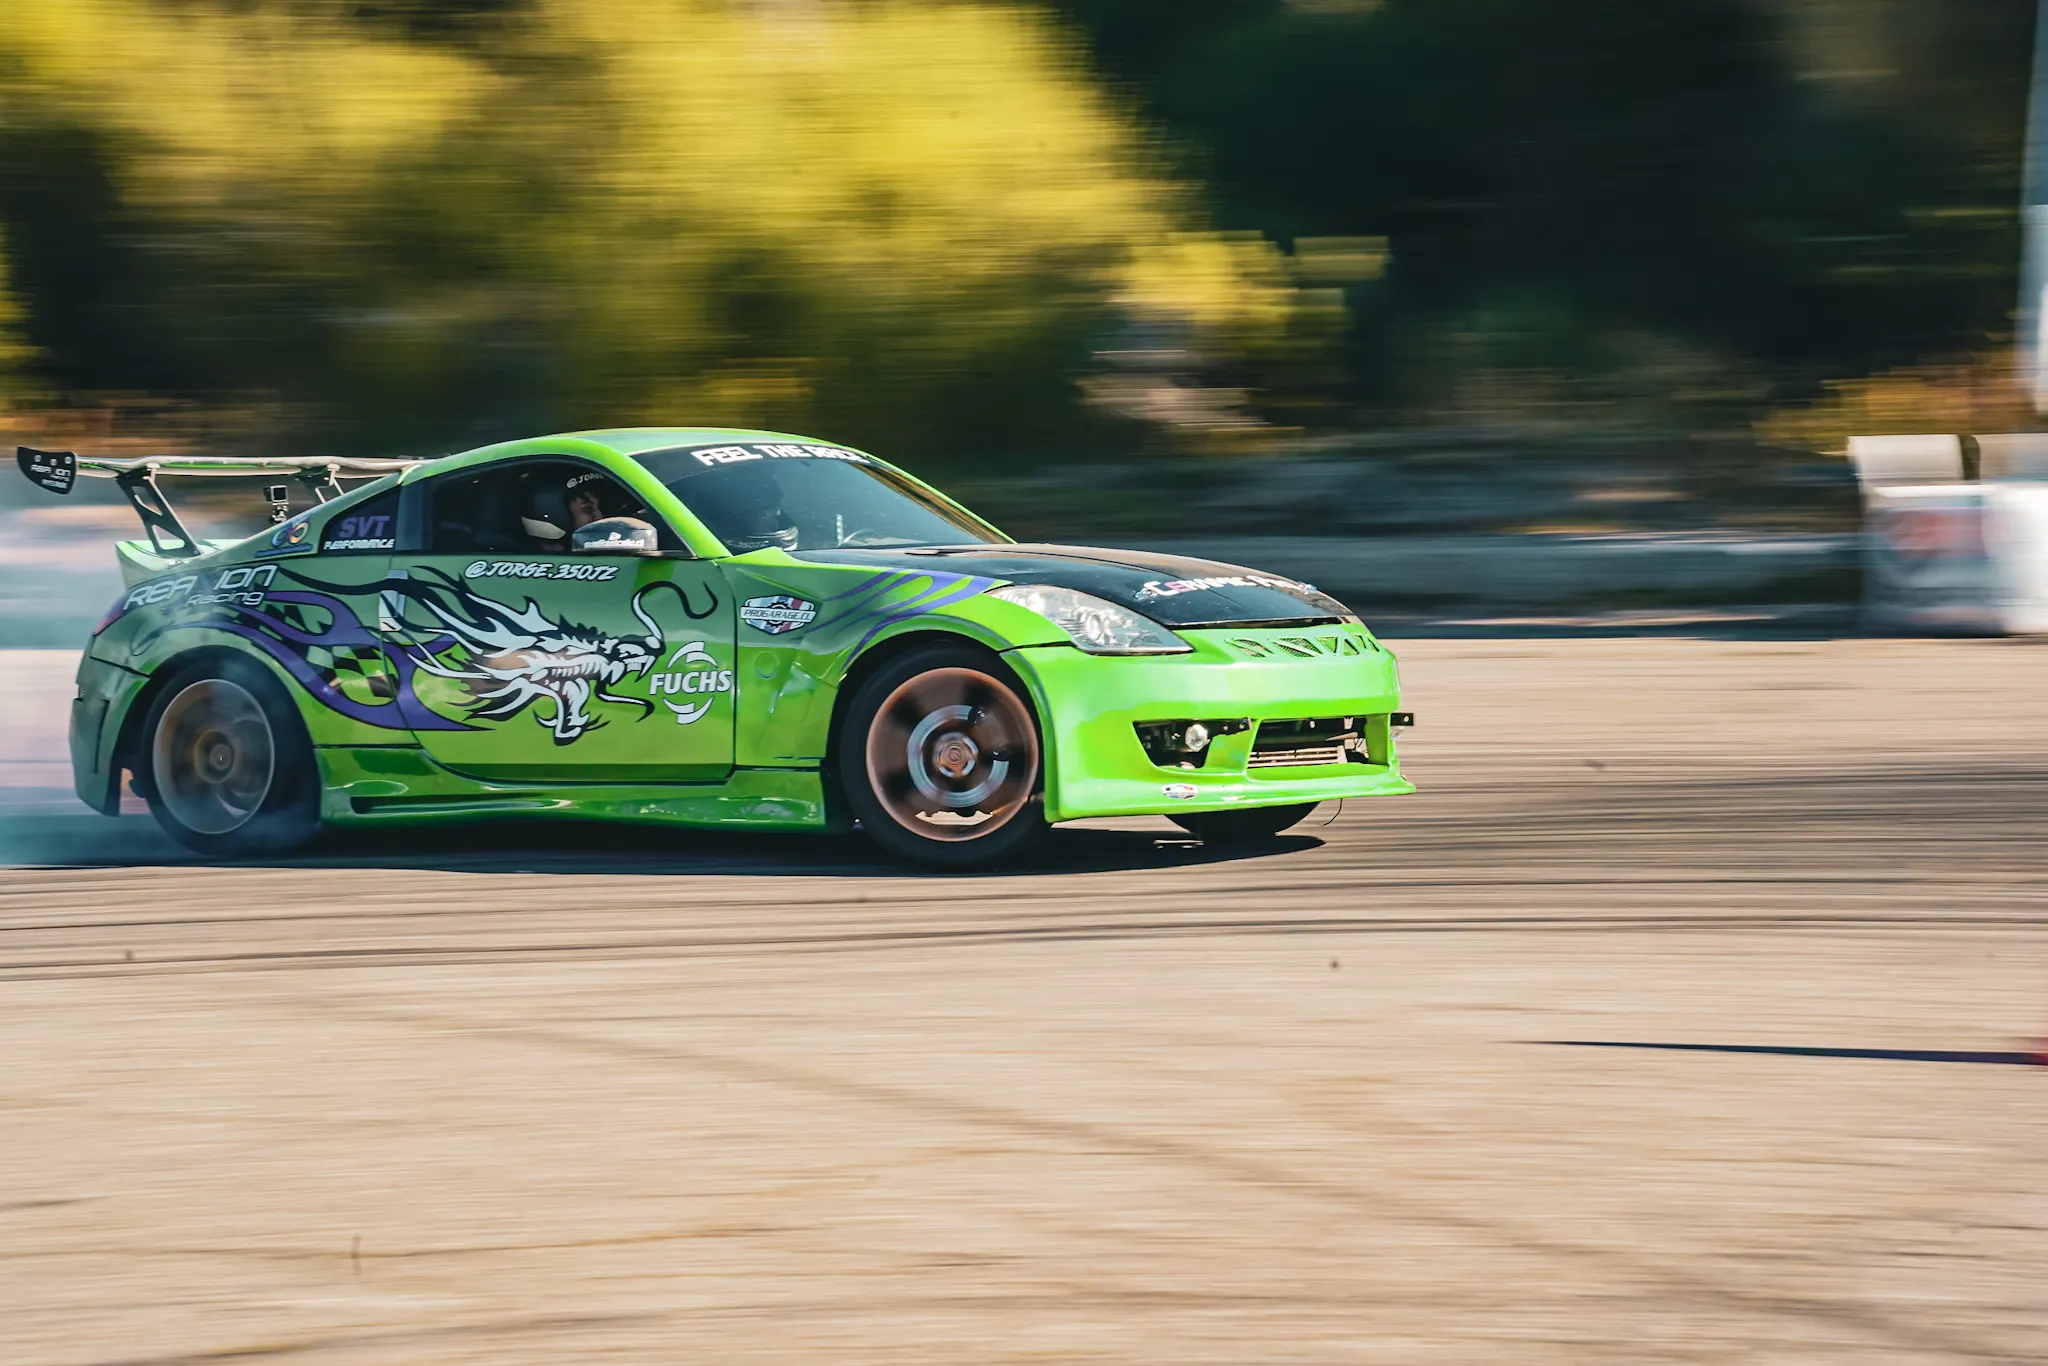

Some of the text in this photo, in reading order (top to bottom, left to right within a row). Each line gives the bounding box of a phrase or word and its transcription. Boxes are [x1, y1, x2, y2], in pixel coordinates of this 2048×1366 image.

[690, 445, 763, 466] FEEL
[752, 444, 812, 458] THE
[339, 515, 391, 538] SVT
[323, 538, 396, 550] PERFORMANCE
[649, 670, 732, 695] FUCHS
